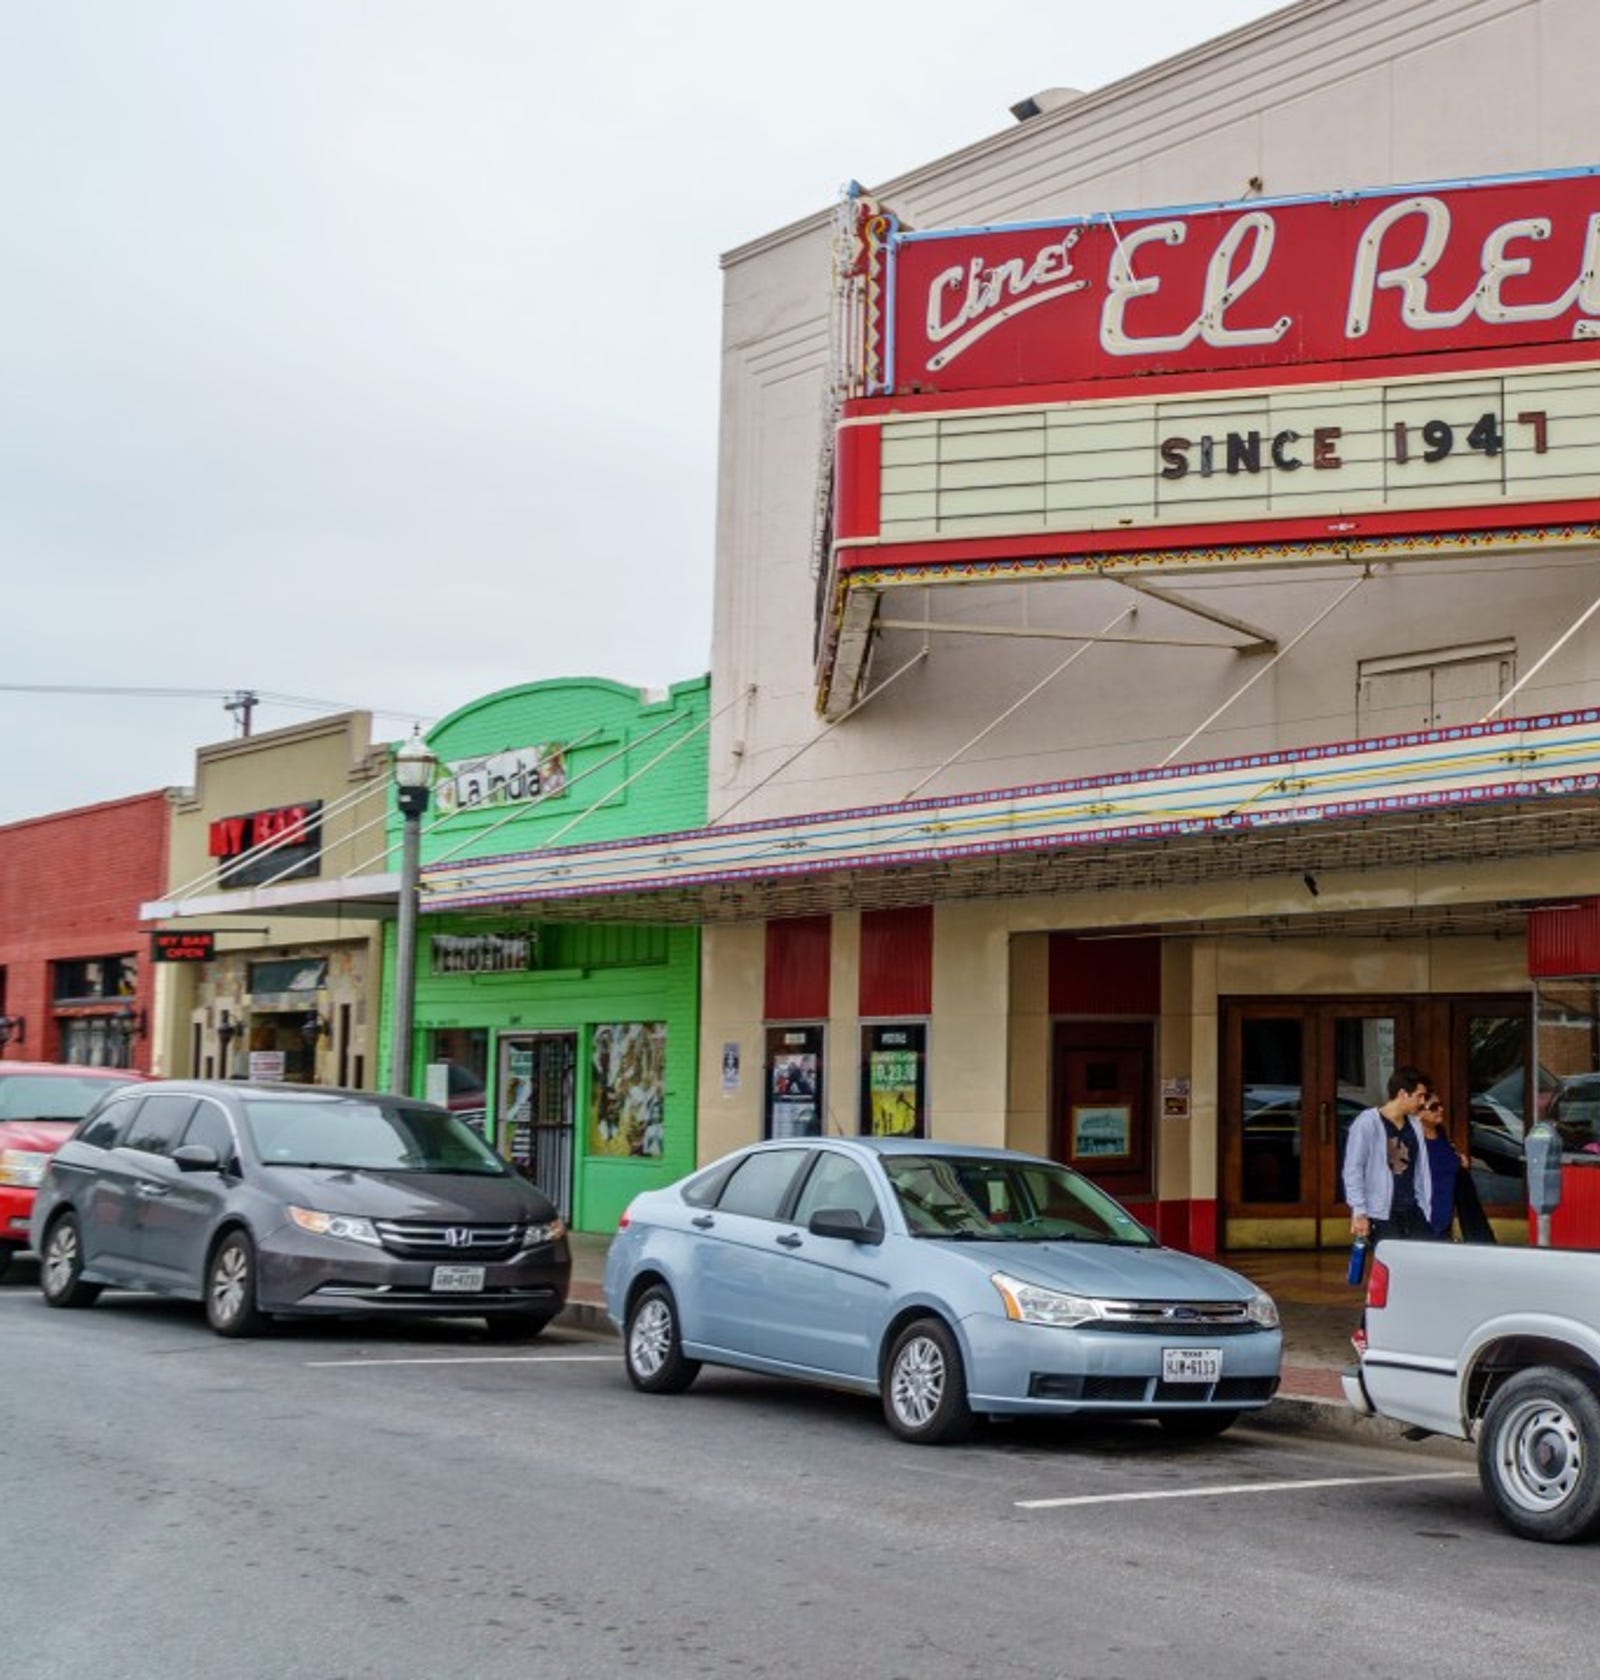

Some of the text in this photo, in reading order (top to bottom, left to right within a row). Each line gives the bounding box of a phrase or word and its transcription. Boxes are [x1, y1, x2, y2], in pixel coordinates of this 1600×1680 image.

[1100, 211, 1291, 355] El
[1160, 411, 1548, 479] SINCE 1947
[166, 948, 204, 958] OPEN
